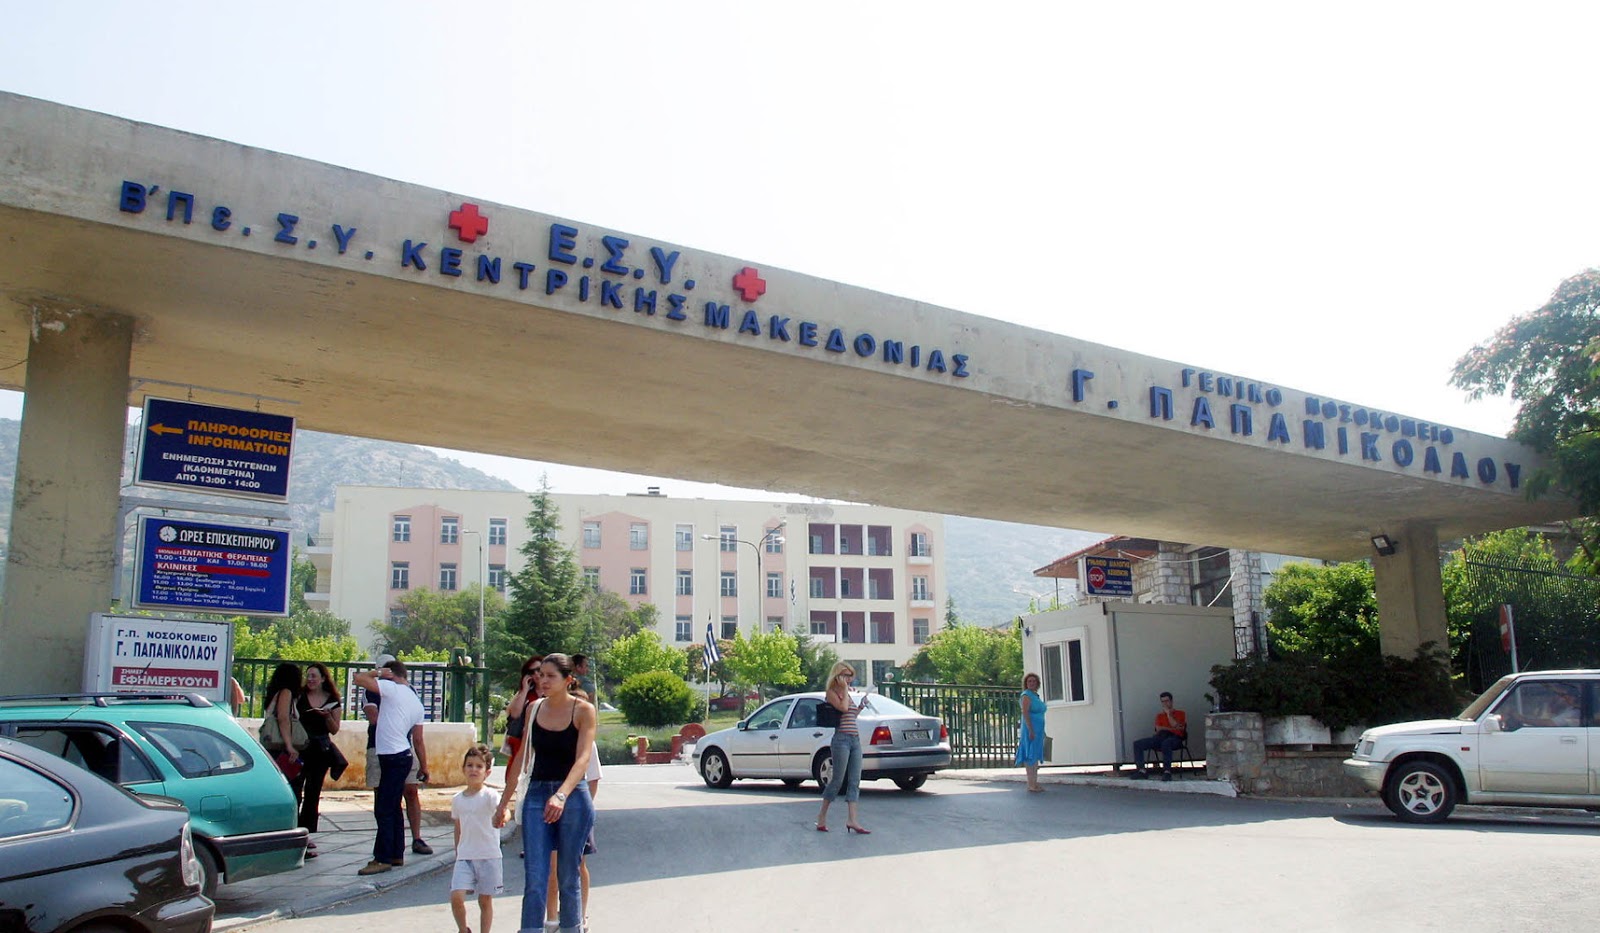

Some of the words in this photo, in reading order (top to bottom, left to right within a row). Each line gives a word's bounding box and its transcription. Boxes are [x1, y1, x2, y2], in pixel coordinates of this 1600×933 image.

[401, 239, 688, 321] ΚΕΝΤΡΙΚΗΣ
[704, 301, 970, 378] ΜΑΚΕΔΟΝΙΑΣ
[1182, 368, 1283, 407] ΓΕΝΙΚΟ
[1305, 397, 1454, 445] ΝΟΣΟΚΟΜΕΙΟ
[187, 420, 291, 443] ΠΛΗΡΟΦΟΡΙΕΣ
[1072, 368, 1118, 409] Γ.
[1150, 385, 1521, 489] ΠΑΠΑΝΙΚΟΛΑΟΥ
[188, 434, 288, 456] INFORMATION
[162, 452, 225, 466] ΕΝΗΜΕΡΩΣΗ
[227, 459, 277, 472] ΣΥΓΓΕΝΩΝ
[175, 473, 197, 482] ΑΠΟ
[200, 475, 227, 485] 13:00
[235, 478, 261, 489] 14:00
[180, 529, 204, 544] ΩΡΕΣ
[206, 532, 276, 550] ΕΠΙΣΚΕΠΤΗΡΙΟΥ
[182, 550, 224, 559] ΕΝΤΑΤΙΚΗΣ
[227, 553, 269, 562] ΘΕΡΑΠΕΙΑΣ
[157, 563, 198, 571] ΚΛΙΝΙΚΕΣ
[117, 629, 140, 639] Γ.Π.
[147, 631, 218, 642] ΝΟΣΟΚΟΜΕΙΟ
[116, 641, 127, 657] Γ.
[134, 642, 218, 661] ΠΑΠΑΝΙΚΟΛΑΟΥ
[120, 675, 213, 688] ΕΦΗΜΕΡΕΥΟΥΝ
